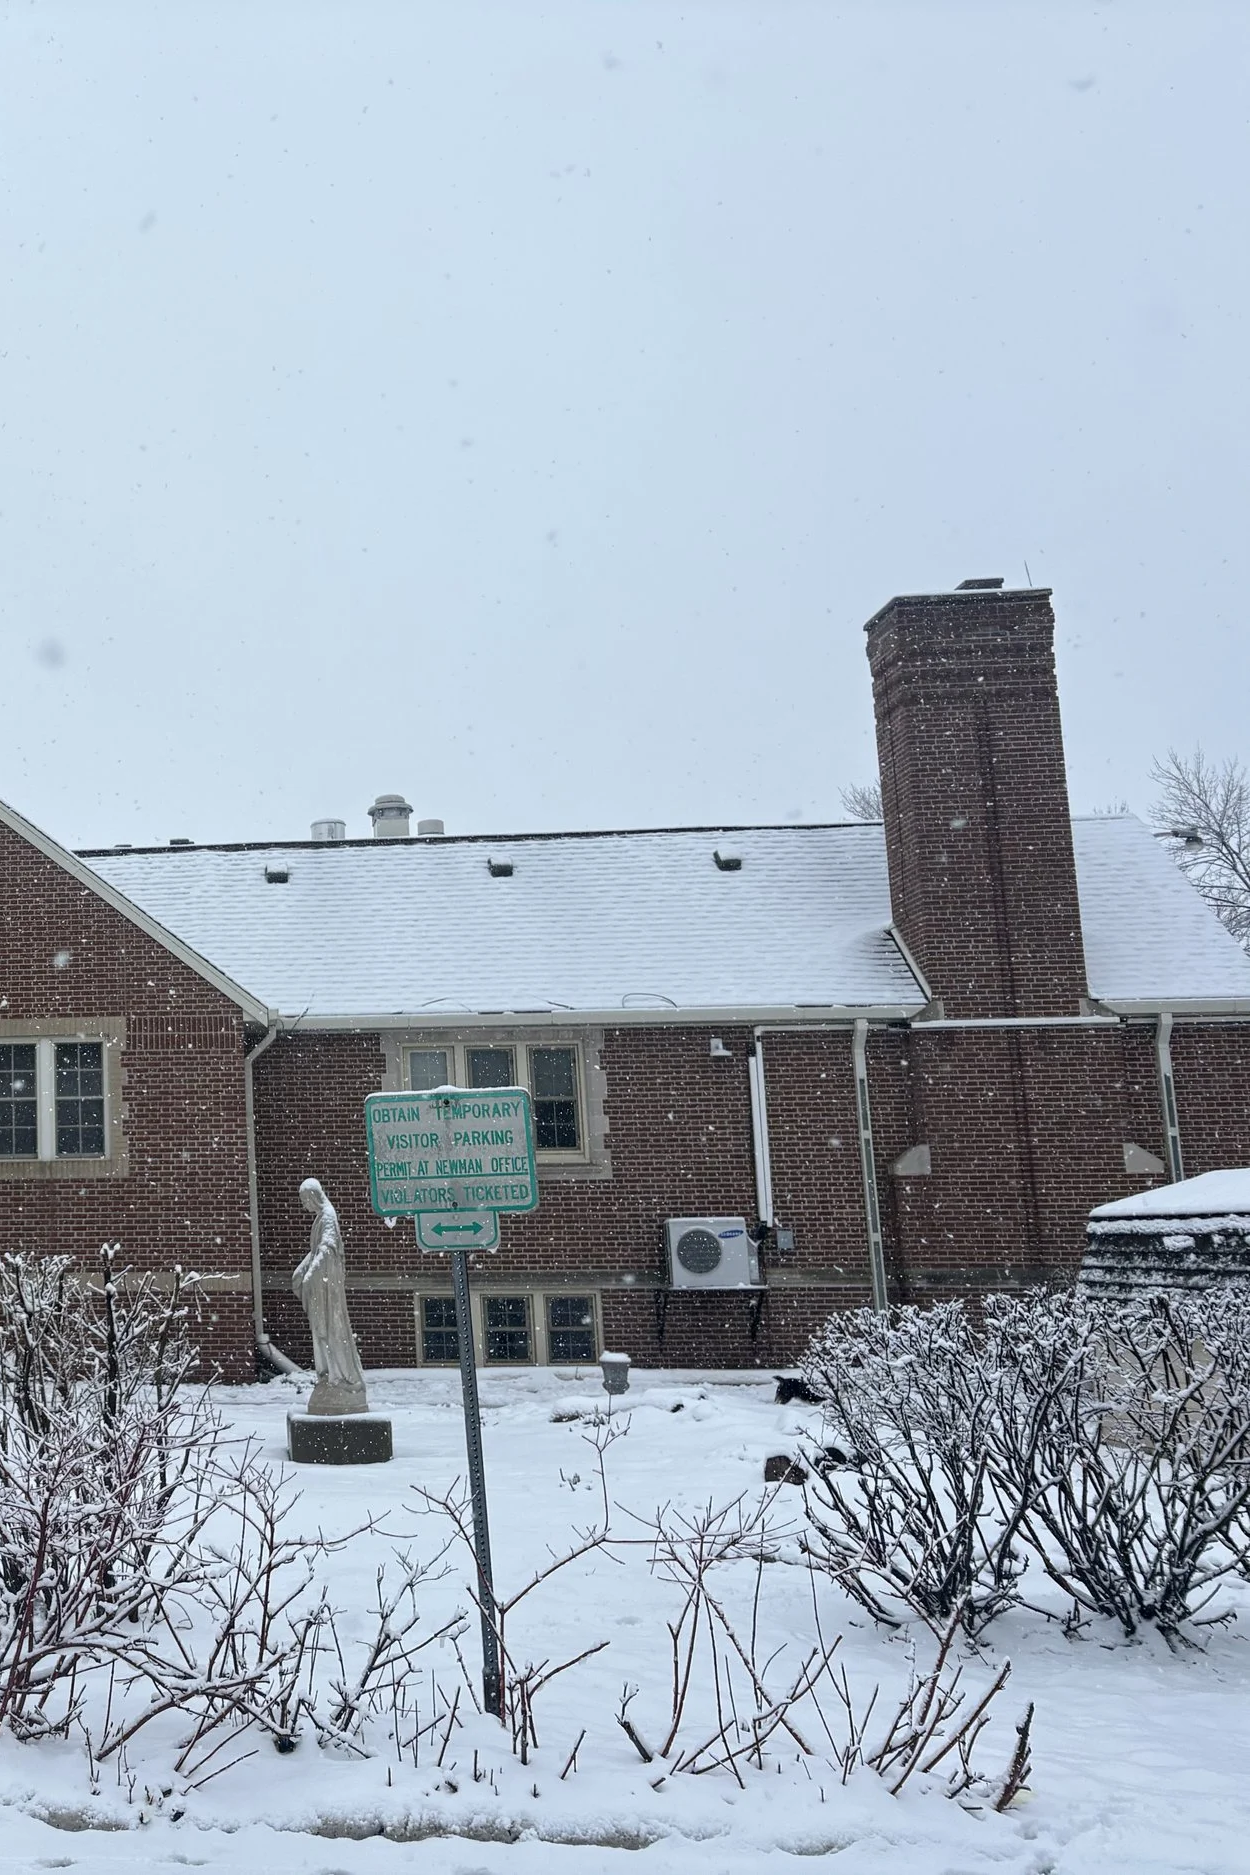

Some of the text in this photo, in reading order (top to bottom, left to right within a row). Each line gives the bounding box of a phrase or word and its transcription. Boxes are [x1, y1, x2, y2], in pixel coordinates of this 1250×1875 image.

[372, 1101, 521, 1124] OBTAIN TEMPORARY
[386, 1130, 514, 1150] VISITOR PARKING
[377, 1156, 528, 1177] PERMIT AT NEWMAN OFFICE
[381, 1184, 529, 1205] VIOLATORS TICKETED
